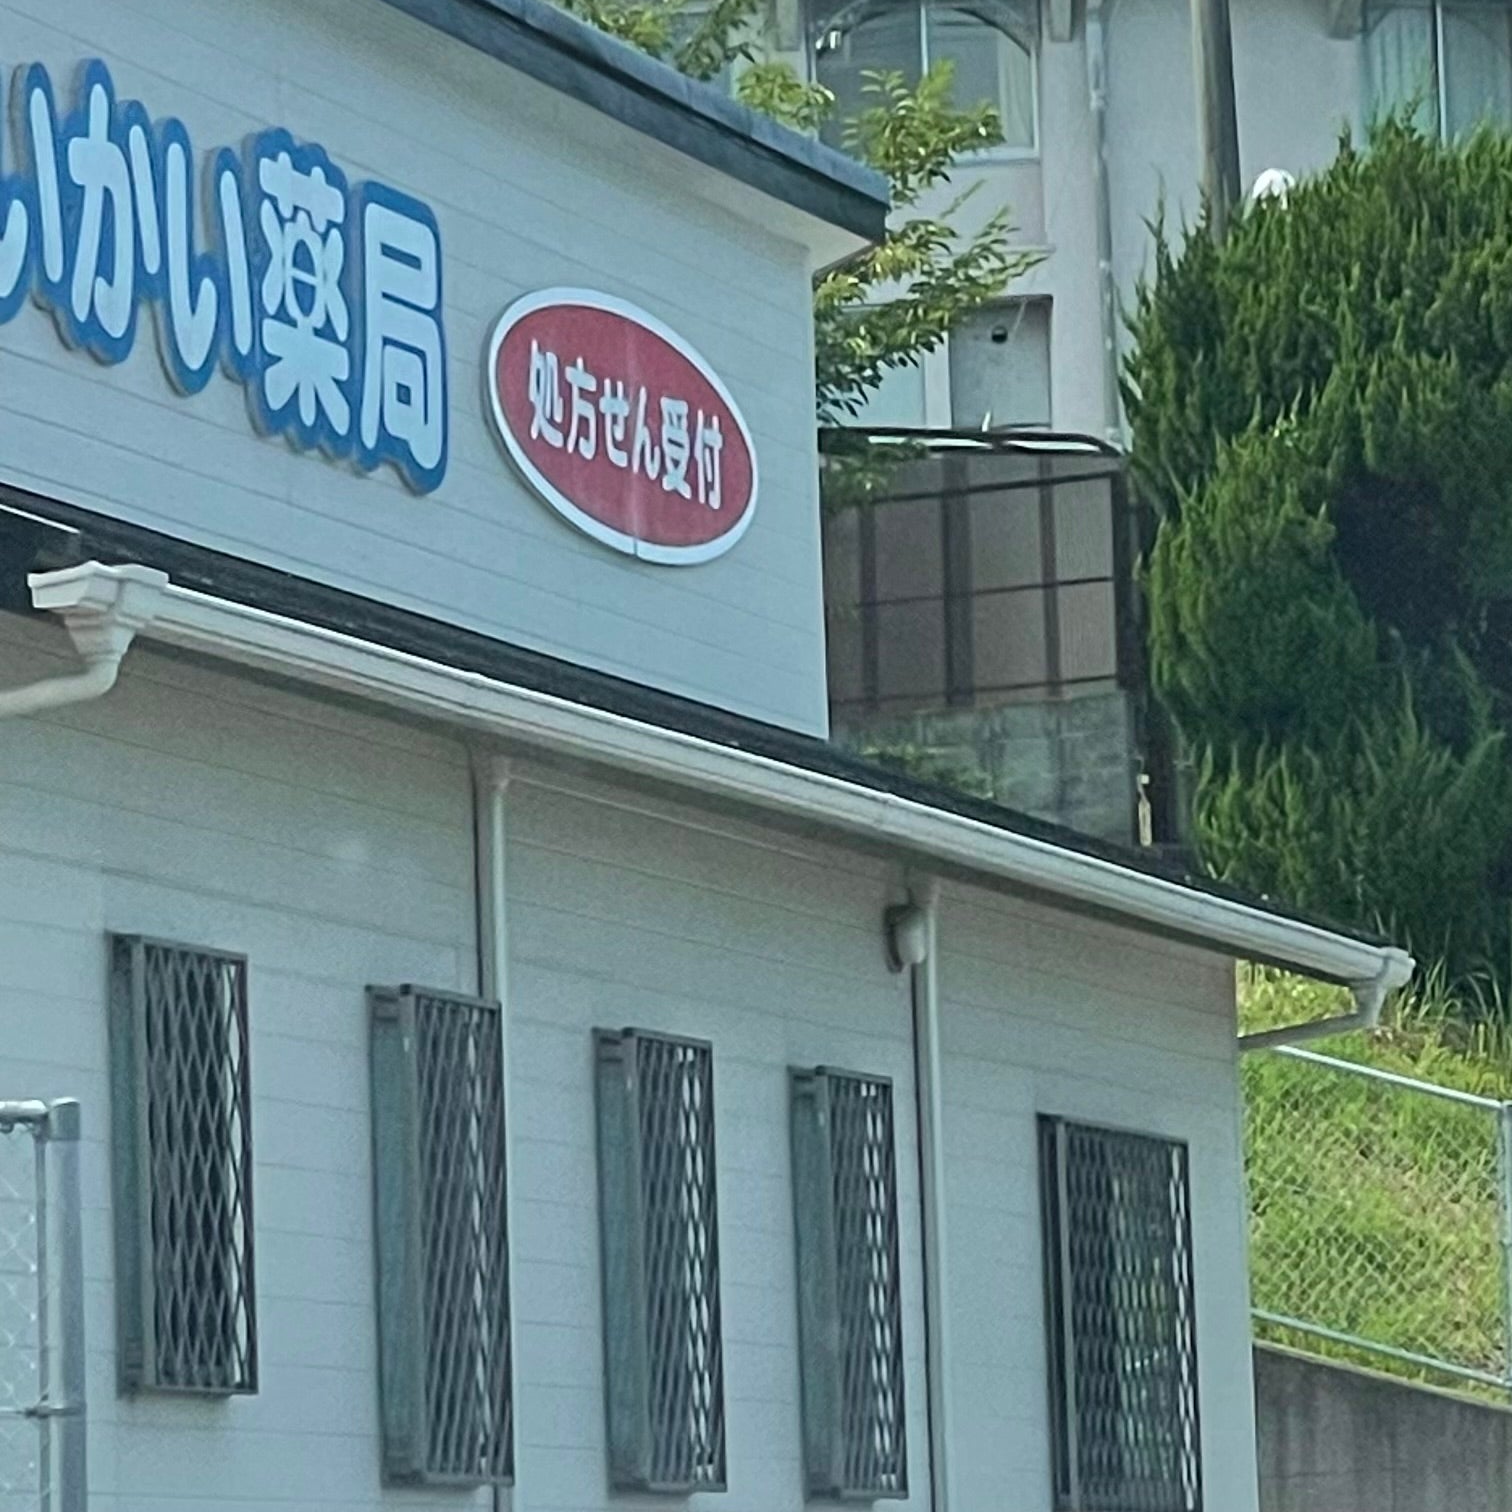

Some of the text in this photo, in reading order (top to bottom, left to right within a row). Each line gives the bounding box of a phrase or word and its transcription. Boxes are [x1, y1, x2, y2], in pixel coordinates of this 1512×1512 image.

[528, 339, 723, 510] 処方せん受付
